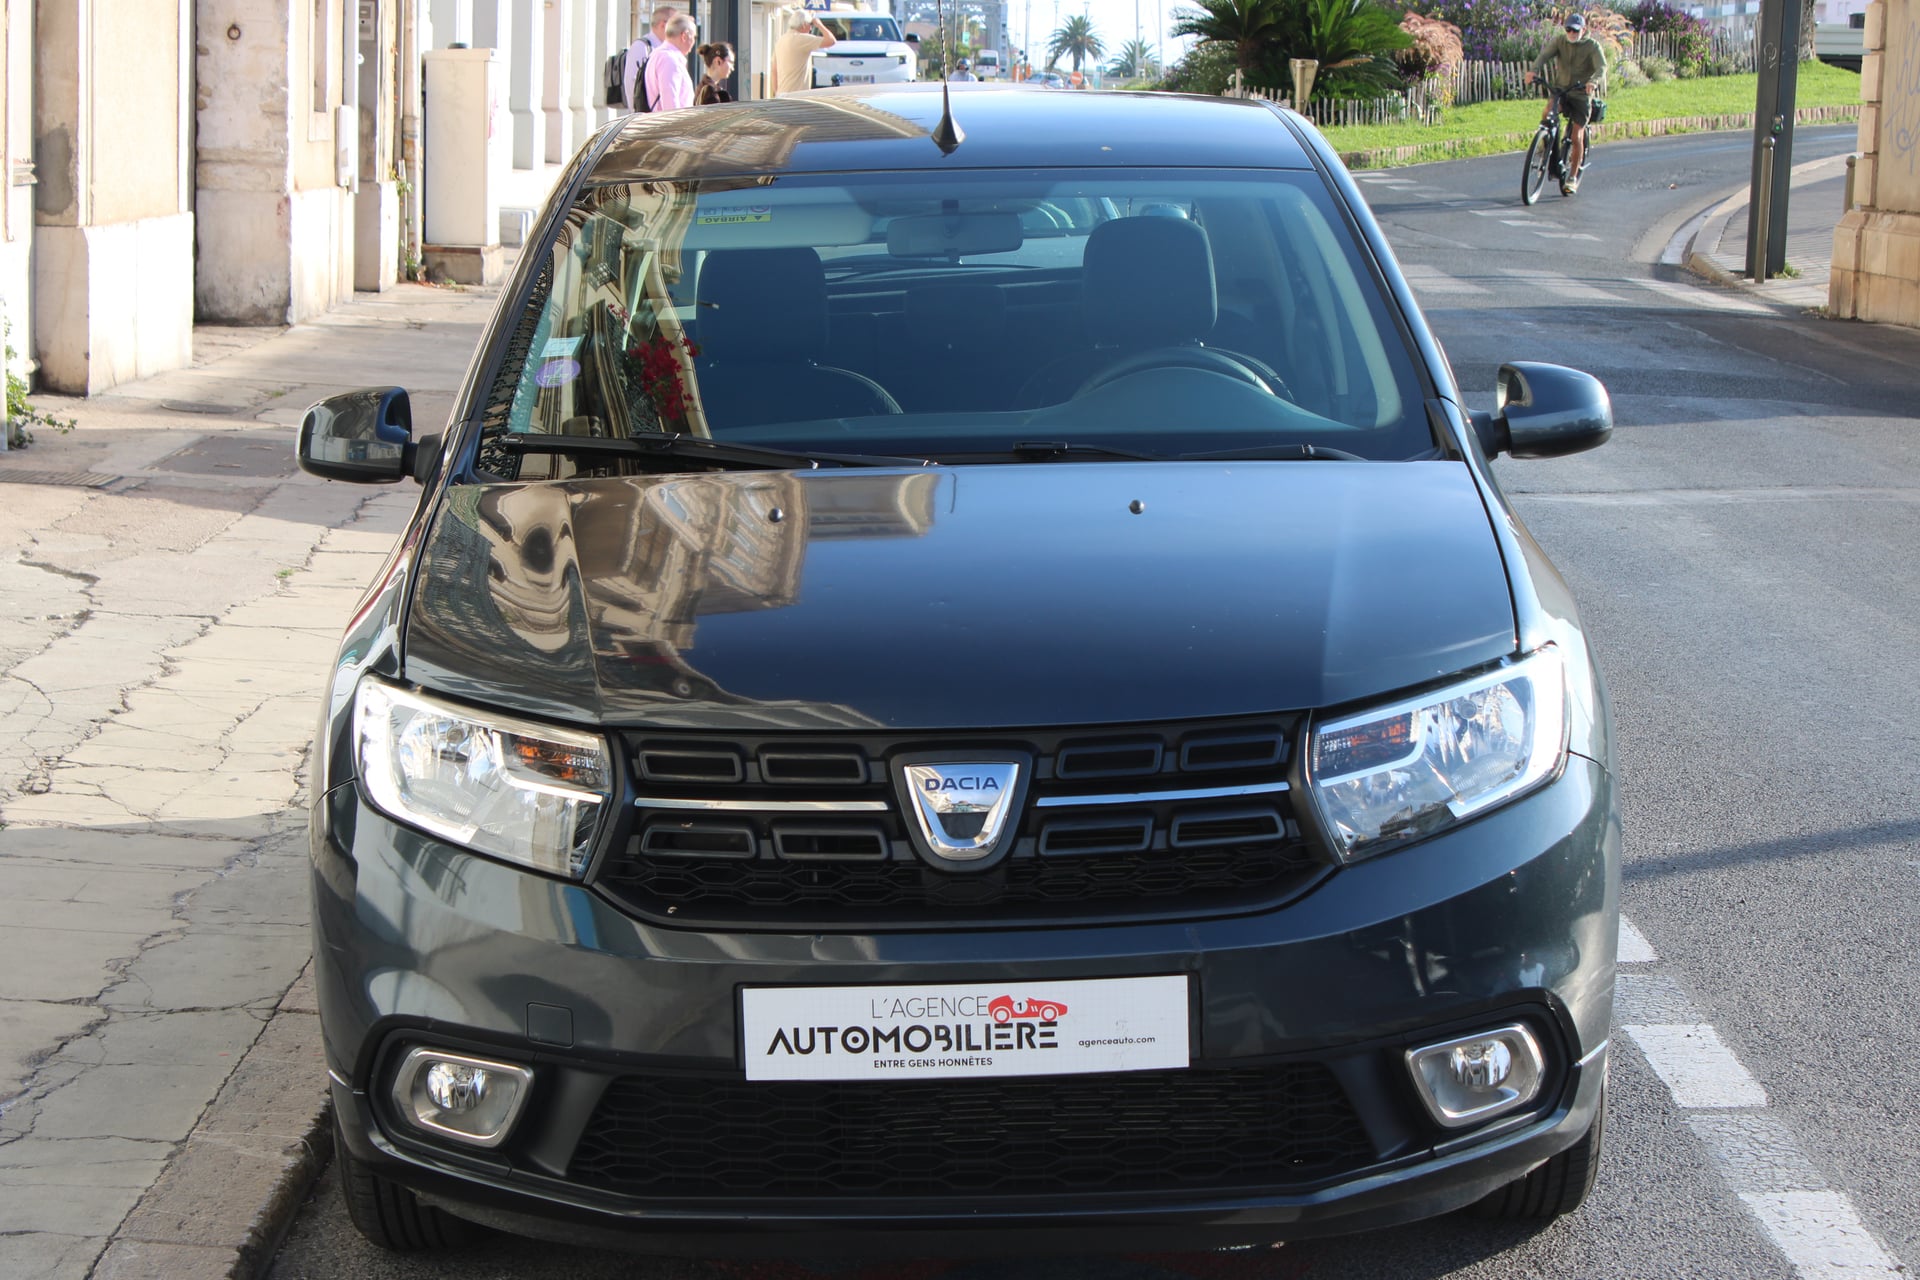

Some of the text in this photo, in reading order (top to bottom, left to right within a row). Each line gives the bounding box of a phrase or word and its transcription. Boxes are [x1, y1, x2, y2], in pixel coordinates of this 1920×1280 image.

[705, 215, 747, 224] AIRBAG
[925, 776, 999, 792] DACIA
[871, 996, 988, 1019] L'AGENCE
[1017, 1002, 1022, 1011] 1
[1078, 1036, 1156, 1048] agenceauto.com
[873, 1055, 993, 1068] ENTRE GENS HONNÊTES
